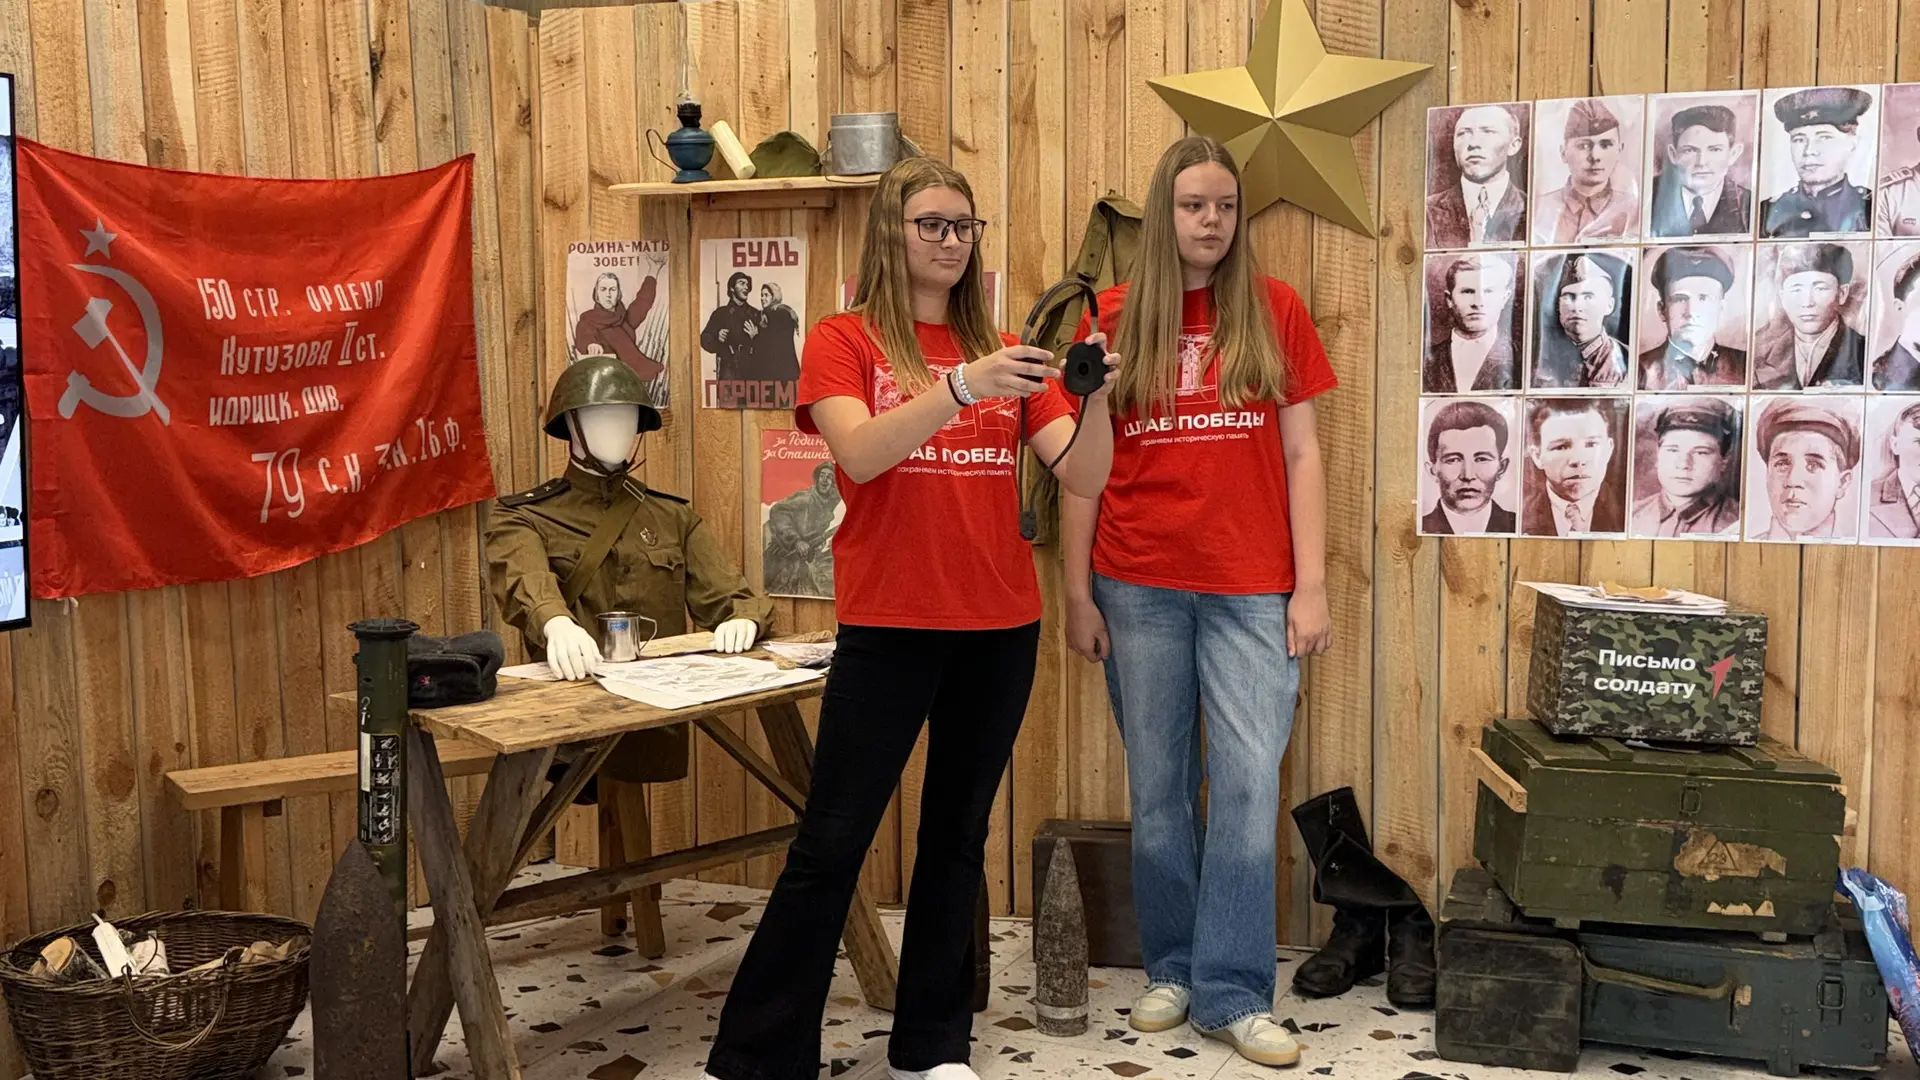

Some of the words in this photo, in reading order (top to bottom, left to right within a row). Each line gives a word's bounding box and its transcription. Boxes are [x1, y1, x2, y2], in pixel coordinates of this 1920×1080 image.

[568, 240, 670, 254] РОДИНА-МАТЬ
[732, 241, 799, 267] БУДЬ
[593, 256, 640, 267] ЗОВЕТ!
[196, 278, 237, 320] 150
[705, 380, 799, 408] ГЕРОЕМ
[1178, 411, 1266, 430] ПОБЕДЫ
[908, 445, 937, 461] АБ
[251, 447, 305, 524] 79
[1598, 648, 1696, 671] Письмо
[1593, 677, 1696, 699] солдату
